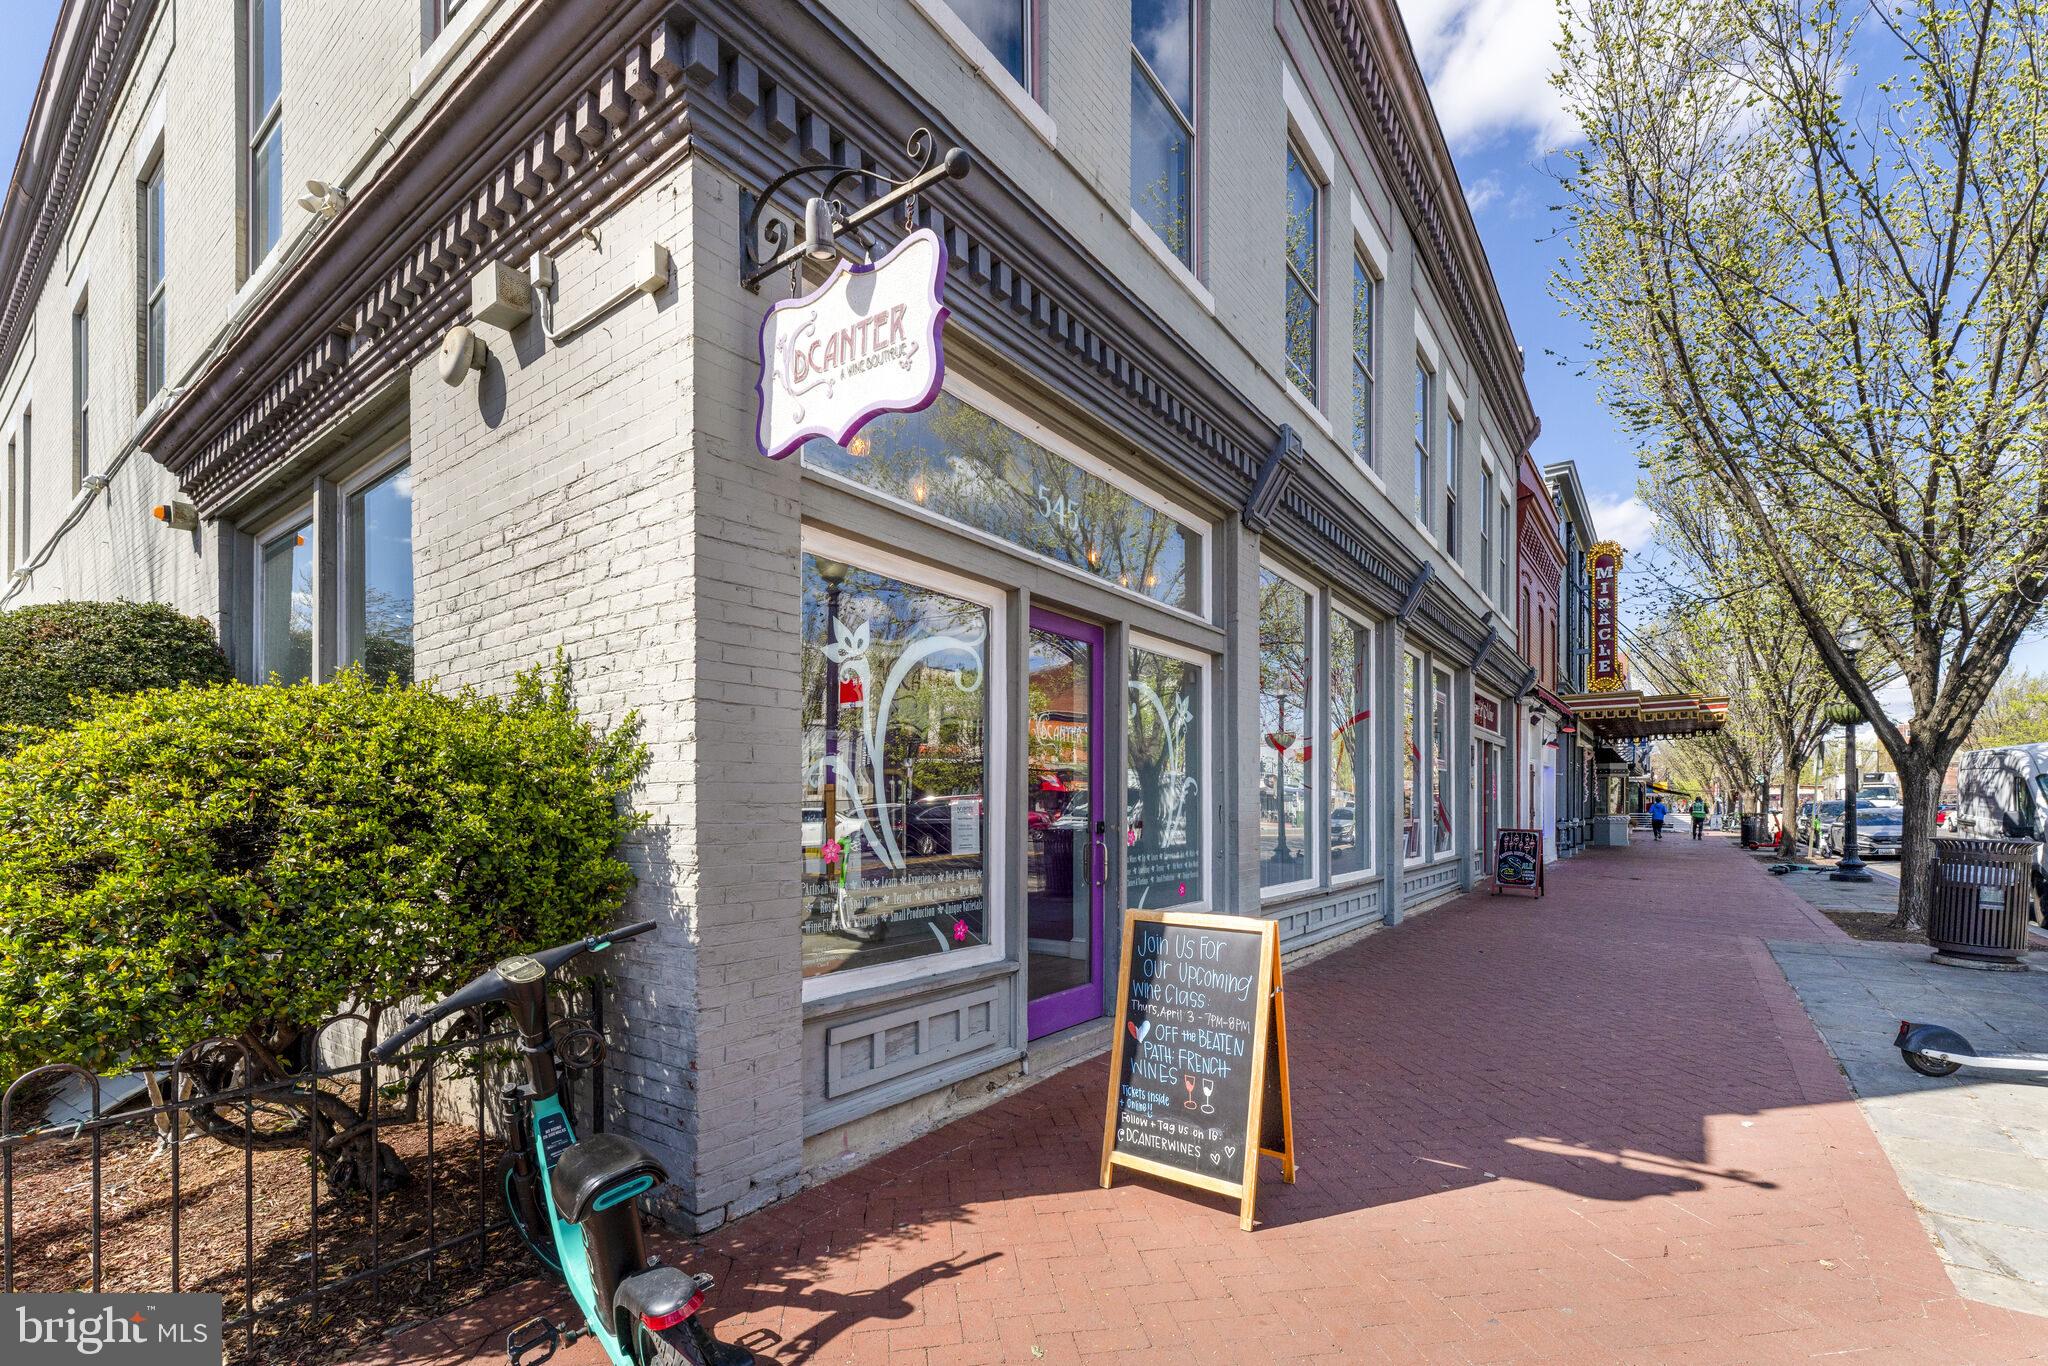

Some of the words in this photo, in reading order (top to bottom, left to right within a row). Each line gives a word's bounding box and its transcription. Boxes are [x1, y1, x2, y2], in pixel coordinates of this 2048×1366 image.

[793, 303, 908, 384] DCANTER
[1039, 484, 1079, 531] 545
[1595, 565, 1614, 673] MIRACLE
[882, 876, 898, 888] Learn
[1137, 930, 1169, 956] Join
[1176, 934, 1195, 959] Us
[1200, 936, 1227, 961] For
[1179, 962, 1253, 1001] Upcoming
[1187, 1011, 1195, 1022] 3
[1155, 1024, 1179, 1043] OFF
[1181, 1030, 1196, 1042] the
[1199, 1028, 1245, 1057] BEATEN
[1130, 1057, 1178, 1085] WINES
[1178, 1049, 1231, 1078] FRENCH
[1122, 1084, 1146, 1100] Tickets
[1121, 1112, 1148, 1127] Follow
[1158, 1120, 1175, 1134] Tag
[1192, 1129, 1204, 1139] on
[1117, 1128, 1201, 1158] @DCANTERWINES
